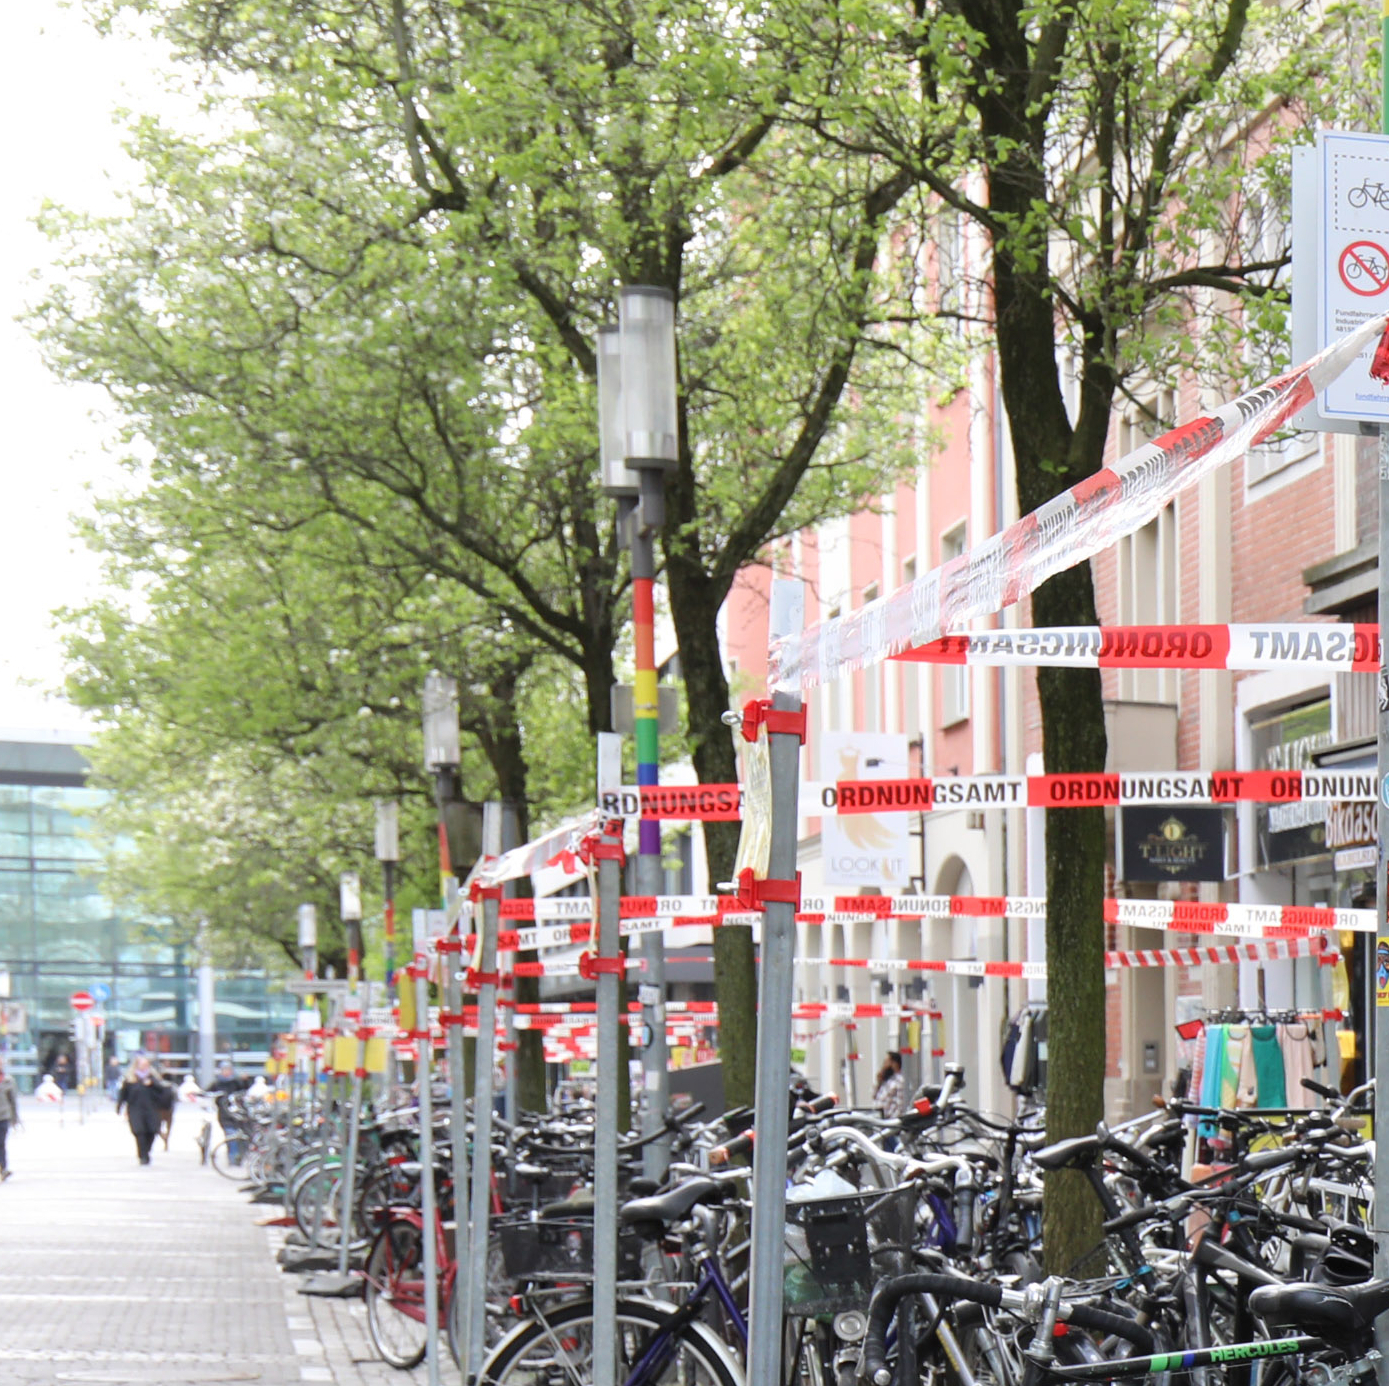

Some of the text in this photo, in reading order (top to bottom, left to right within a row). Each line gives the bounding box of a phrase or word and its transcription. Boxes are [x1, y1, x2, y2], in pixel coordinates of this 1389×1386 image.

[821, 781, 1022, 809] ORDNUNGSAMT
[1050, 777, 1244, 803] ORDNUNGSAMT
[1210, 1340, 1300, 1363] HERCULES
